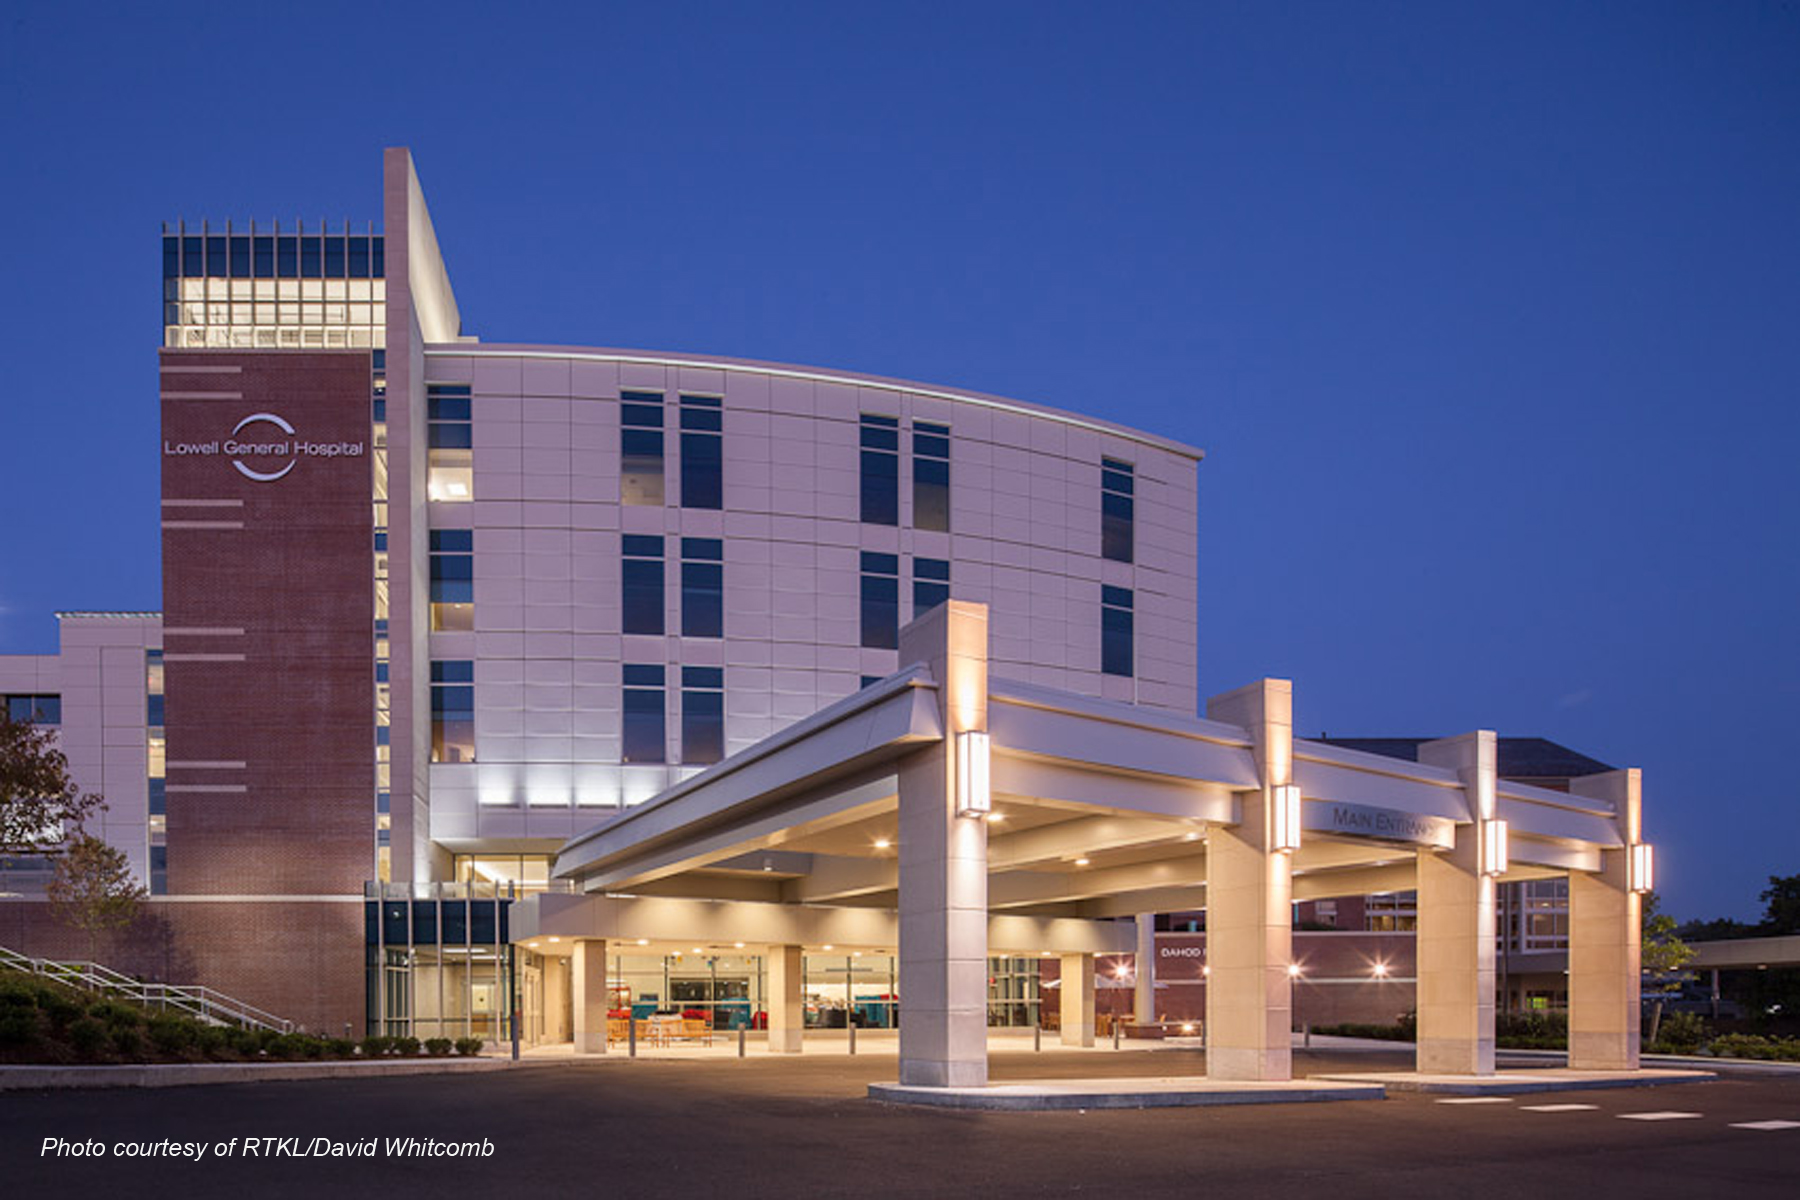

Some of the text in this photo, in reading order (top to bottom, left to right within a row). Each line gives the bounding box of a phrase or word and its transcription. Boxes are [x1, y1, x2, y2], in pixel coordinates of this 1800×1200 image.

[164, 440, 363, 457] Lowell General Hospital
[1333, 807, 1440, 837] MAIN ENTRAN
